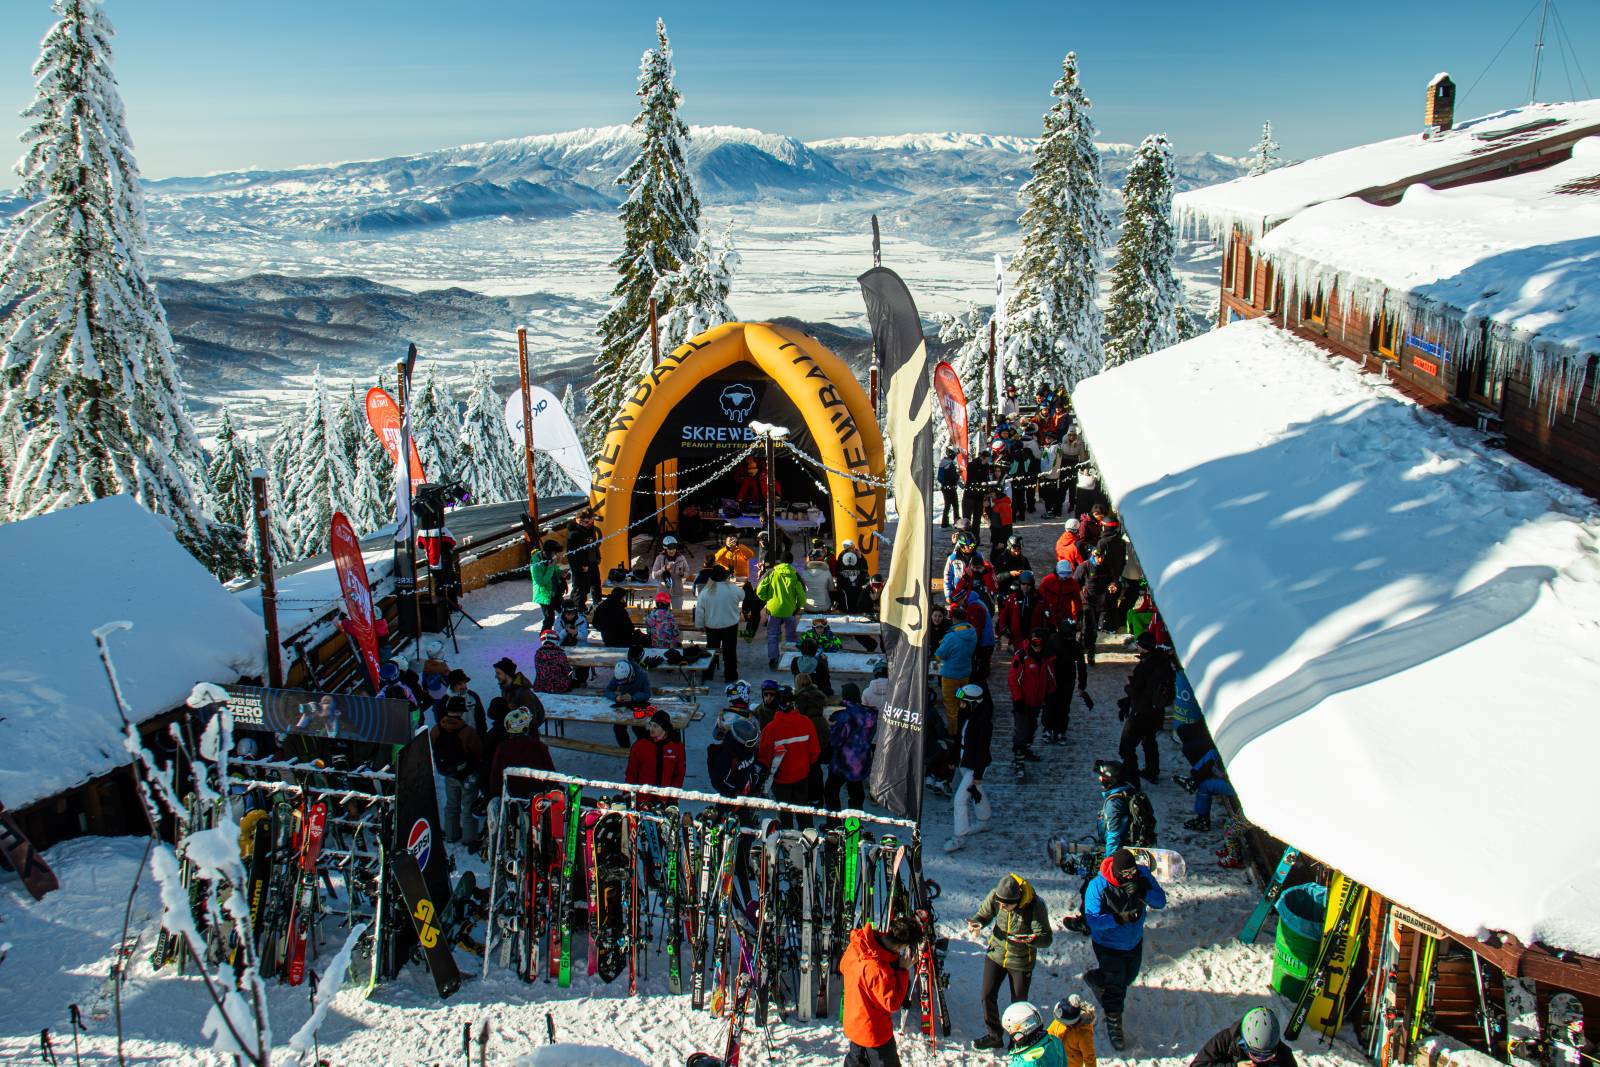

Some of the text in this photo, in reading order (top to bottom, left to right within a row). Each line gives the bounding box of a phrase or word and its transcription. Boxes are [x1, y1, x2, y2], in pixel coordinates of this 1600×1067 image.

[587, 332, 711, 542] KREWBALL
[681, 426, 758, 441] SKREWB
[681, 441, 713, 449] PEANUT
[226, 704, 263, 718] ZERO
[1394, 909, 1439, 935] JANDARMERIA
